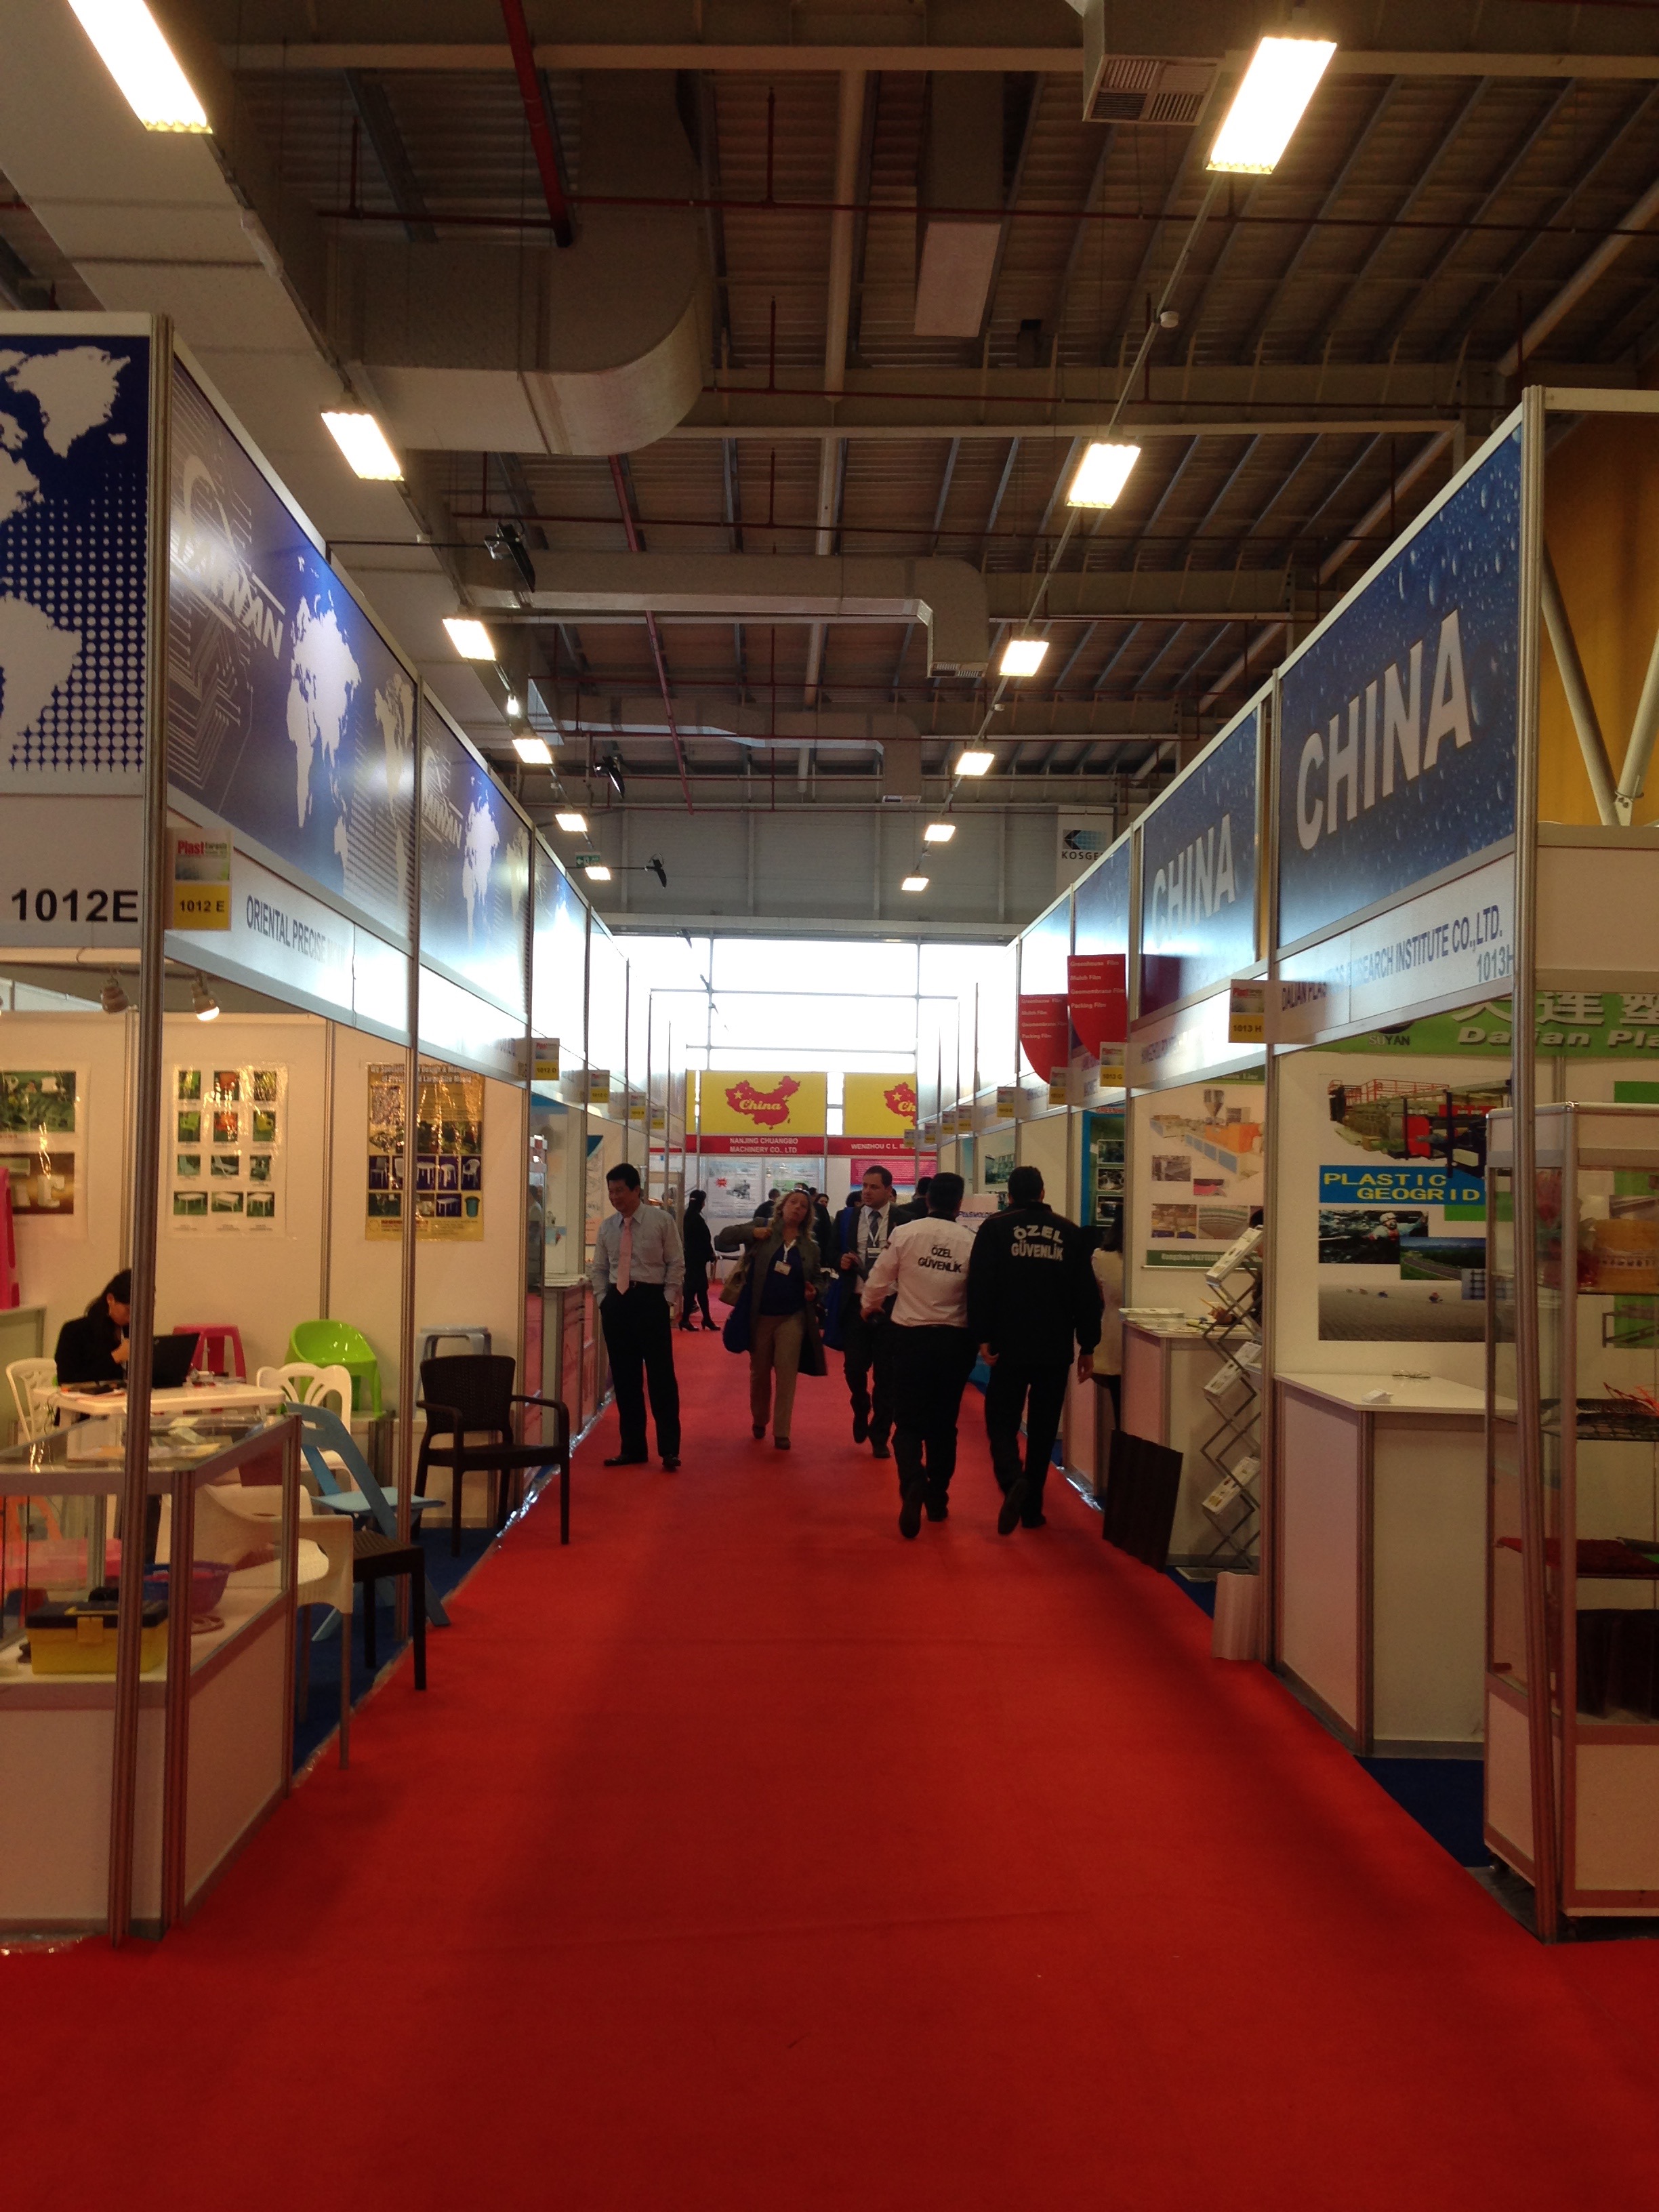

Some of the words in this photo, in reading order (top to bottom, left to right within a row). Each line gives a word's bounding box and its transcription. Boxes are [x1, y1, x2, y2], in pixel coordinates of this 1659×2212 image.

[1296, 609, 1472, 851] CHINA
[178, 840, 205, 855] Plast
[1061, 851, 1104, 860] KOSGE
[1152, 813, 1235, 949] CHINA
[12, 888, 138, 922] 1012E
[180, 900, 211, 912] 1012
[216, 900, 225, 912] E
[246, 895, 291, 947] ORIENTAL
[292, 919, 327, 964] PRECISE
[1395, 923, 1449, 974] INSTITUTE
[1452, 905, 1503, 954] CO.,LTD.
[1233, 1024, 1253, 1033] 1013
[1457, 1027, 1591, 1046] Daan
[1369, 1035, 1410, 1046] SUYAN
[739, 1099, 782, 1111] China
[1324, 1172, 1448, 1186] PLASTIC
[1357, 1187, 1481, 1201] GEOGRID
[1014, 1224, 1063, 1243] ÖZEL
[931, 1244, 953, 1258] ÖZEL
[1011, 1240, 1065, 1261] GÜVENLİK
[918, 1256, 963, 1273] GÜVENLİK
